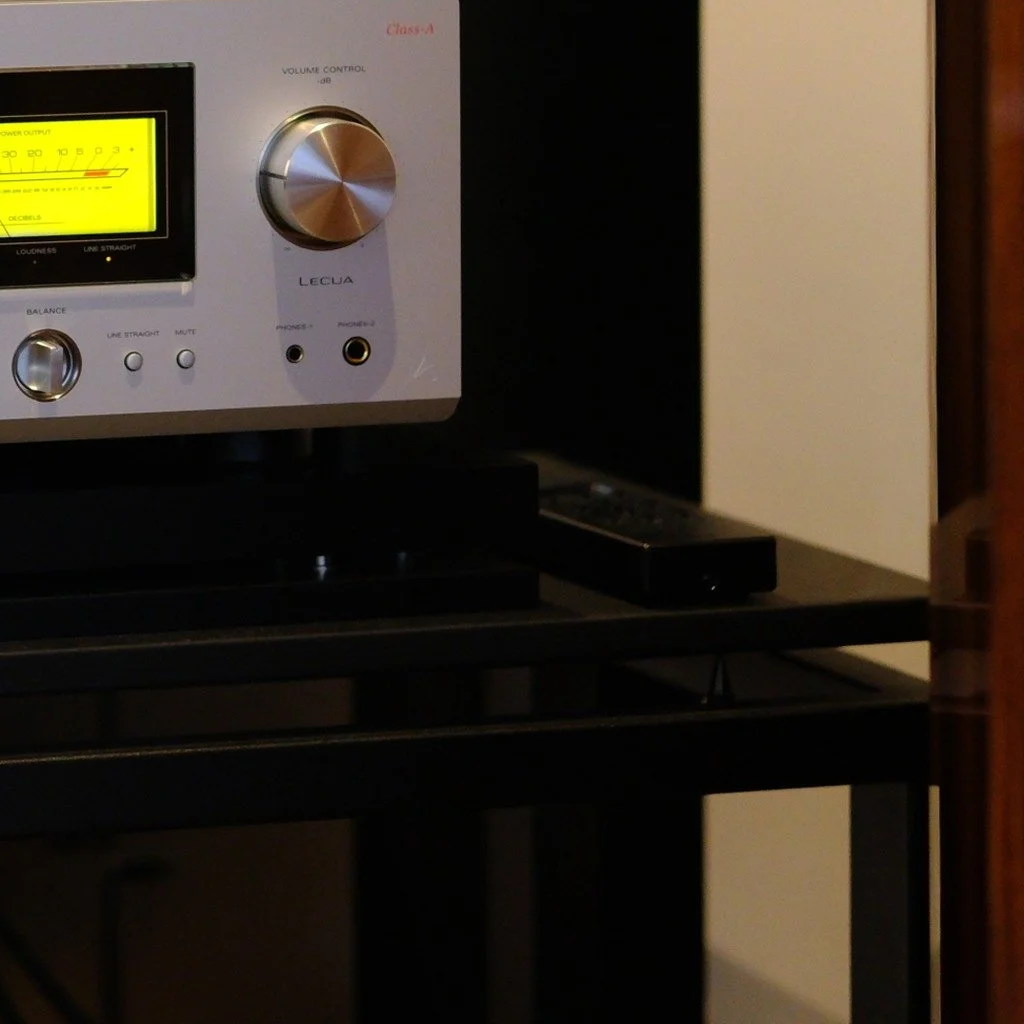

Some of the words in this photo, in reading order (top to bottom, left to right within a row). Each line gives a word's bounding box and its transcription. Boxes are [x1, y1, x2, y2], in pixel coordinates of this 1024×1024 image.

[386, 22, 435, 36] Class-A
[281, 66, 320, 75] VOLUME
[322, 64, 366, 73] CONTROL
[1, 150, 17, 158] 30
[27, 149, 43, 157] 20
[57, 148, 68, 156] 10
[16, 247, 57, 255] LOUDNESS
[100, 244, 137, 252] STRAIGHT
[299, 276, 354, 286] LECUA
[26, 307, 67, 315] BALANCE
[124, 330, 160, 338] STRAIGHT
[174, 328, 197, 336] MUTE
